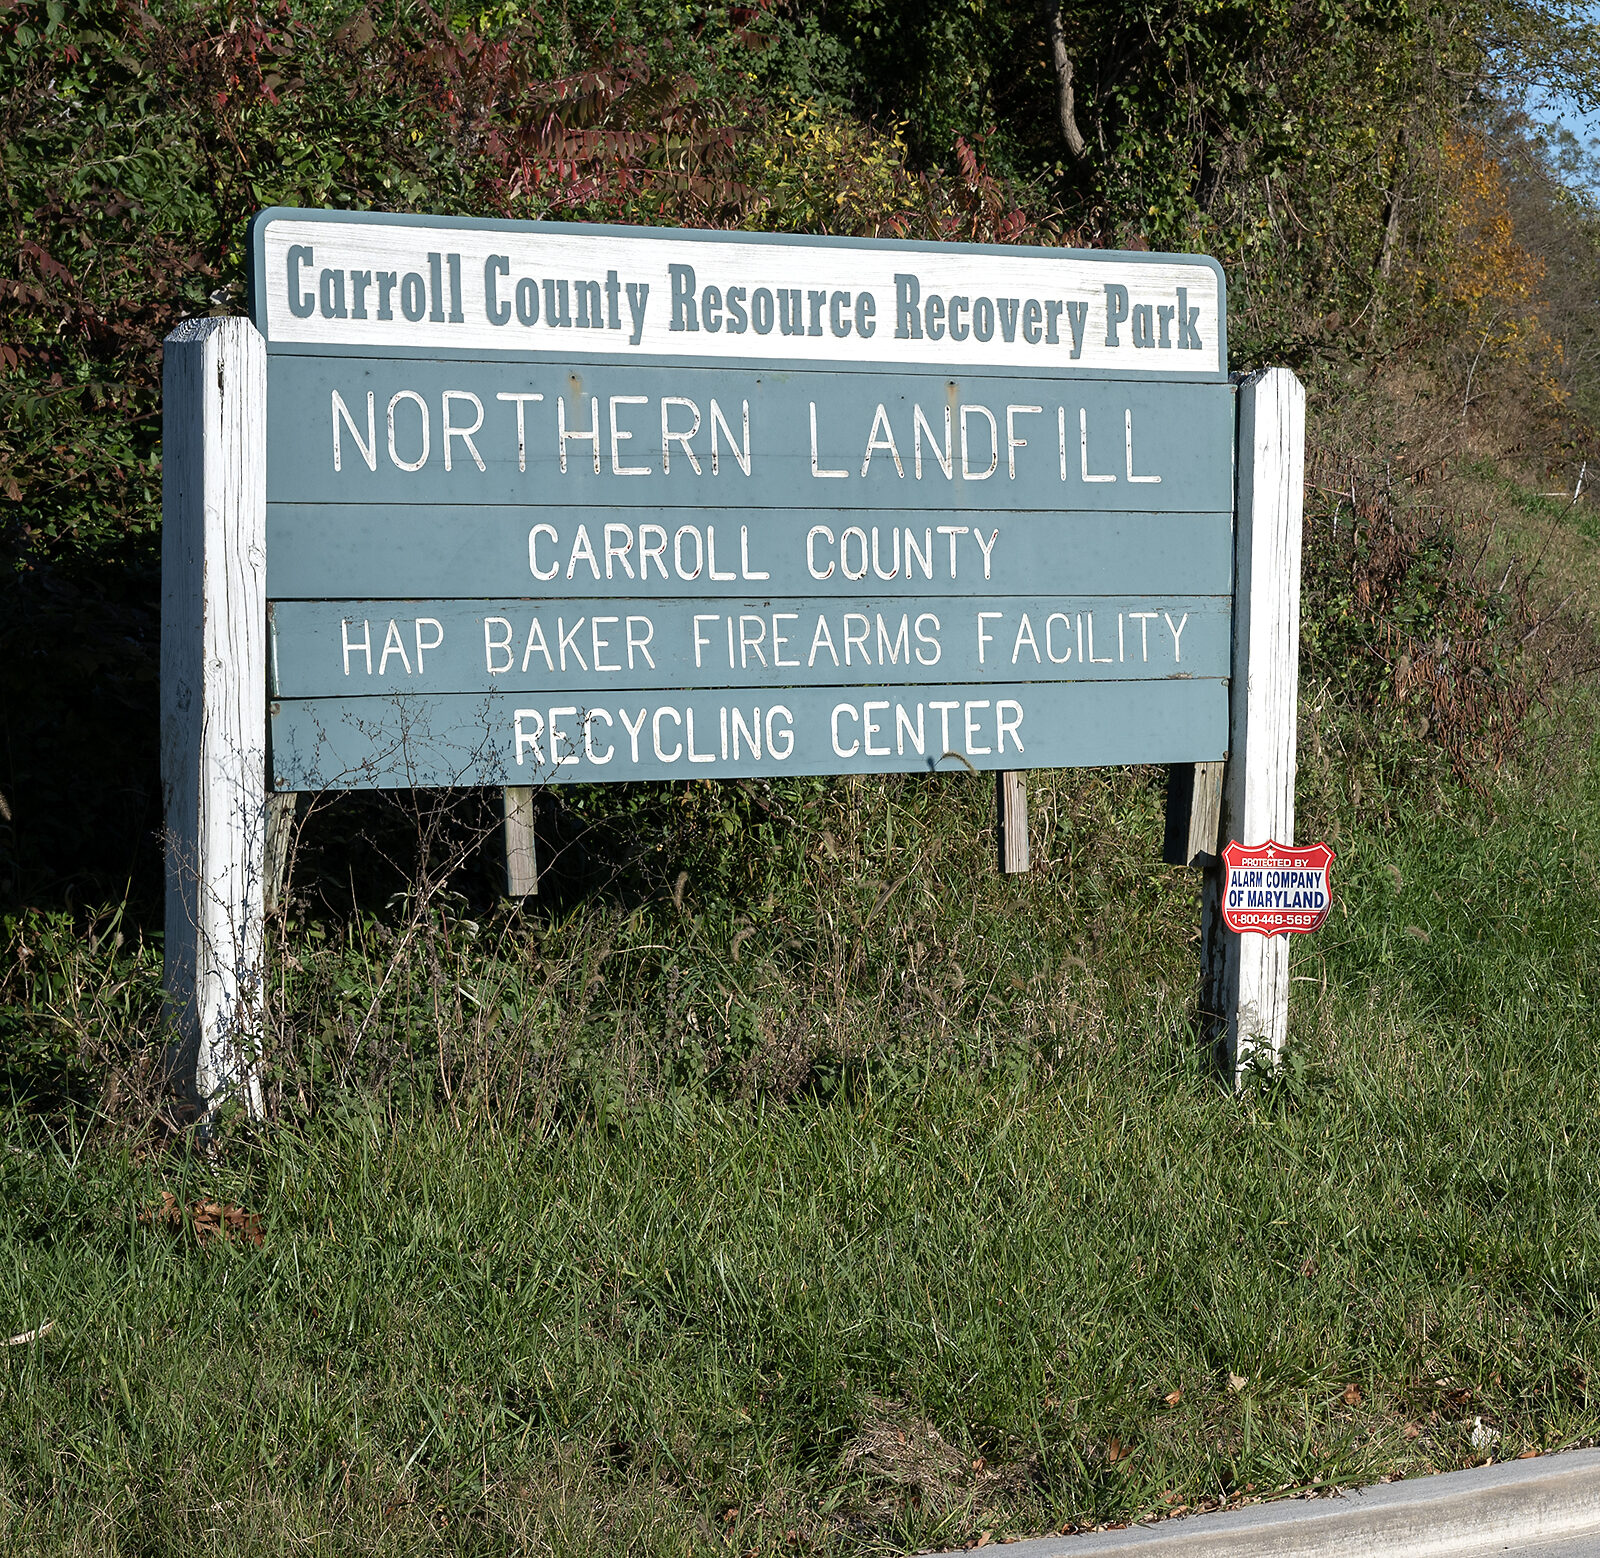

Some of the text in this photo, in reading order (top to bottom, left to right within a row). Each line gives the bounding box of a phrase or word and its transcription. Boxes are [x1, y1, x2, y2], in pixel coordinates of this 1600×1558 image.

[286, 244, 1202, 360] Carroll County Resource Recovery Park
[332, 390, 1161, 482] NORTHERN LANDFILL
[529, 523, 999, 580] CARROLL COUNTY
[342, 612, 1188, 675] HAP BAKER FIREARMS FACILITY
[514, 700, 1024, 765] RECYCLING CENTER
[1231, 871, 1321, 888] ALARM COMPANY
[1241, 858, 1309, 867] PROTECTED BY
[1229, 890, 1324, 908] OF MARYLAND
